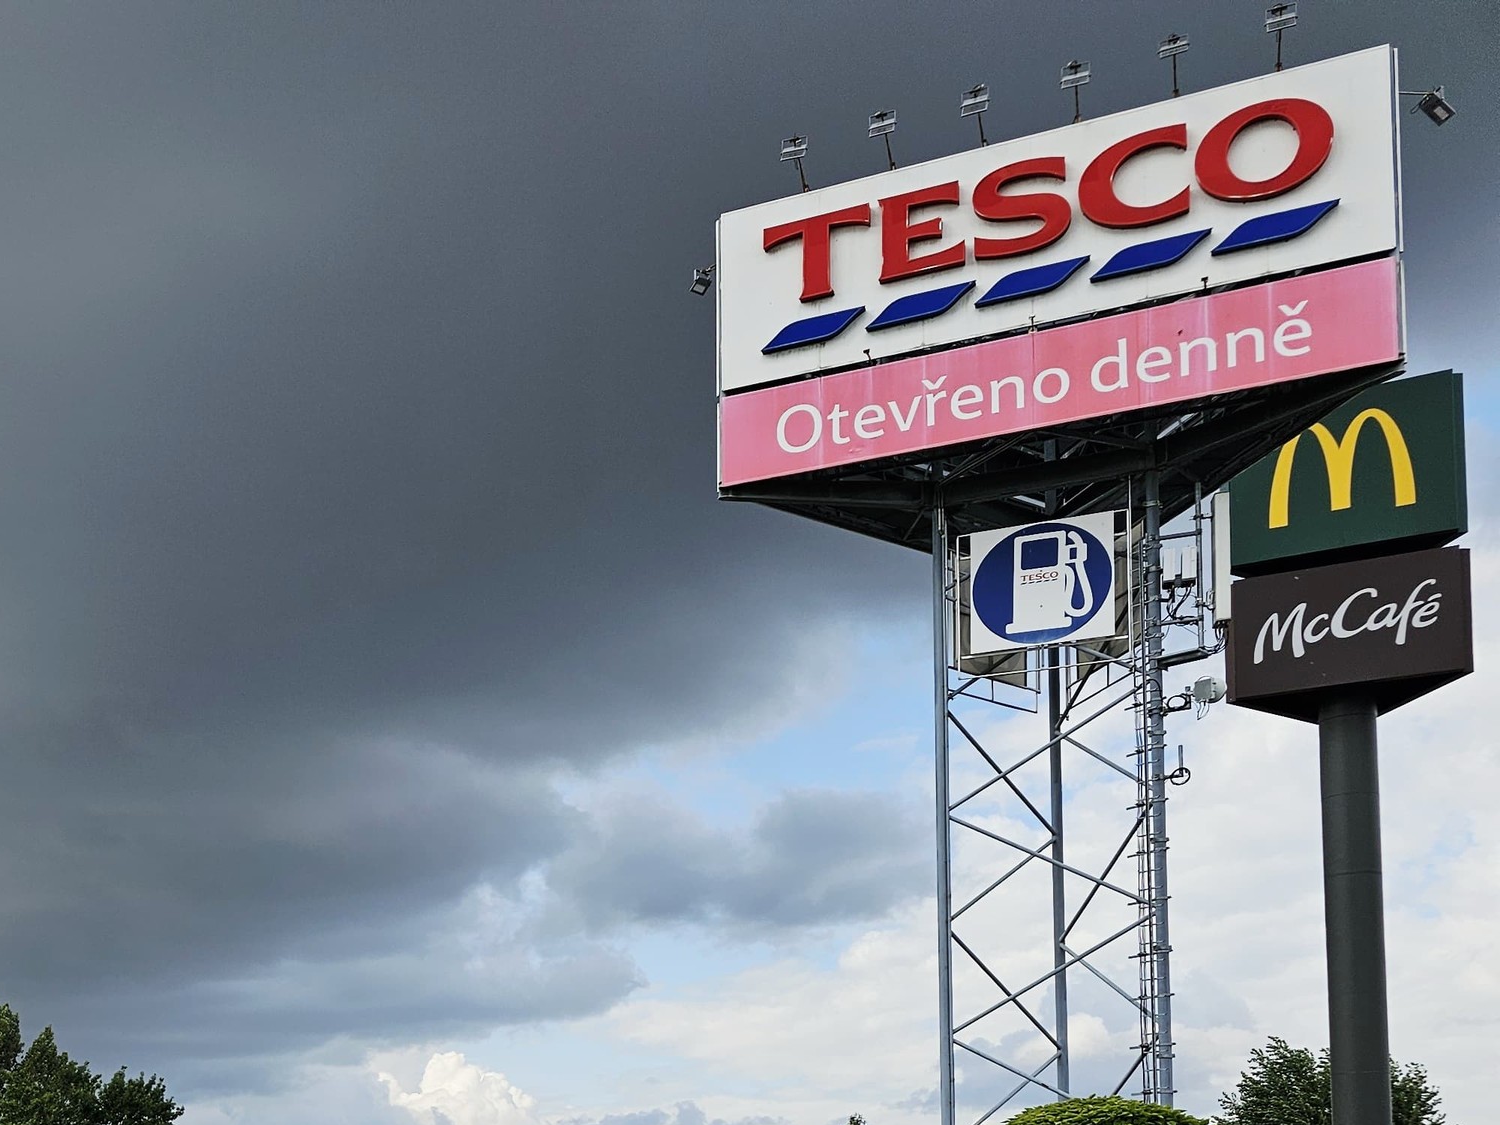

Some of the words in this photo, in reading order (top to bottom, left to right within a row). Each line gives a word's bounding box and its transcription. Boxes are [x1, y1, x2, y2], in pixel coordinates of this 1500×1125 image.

[763, 97, 1335, 303] TESCO
[775, 374, 1071, 454] Otevřeno
[1090, 300, 1312, 393] denně
[1020, 571, 1059, 582] TESCO
[1253, 578, 1443, 665] McCafé
